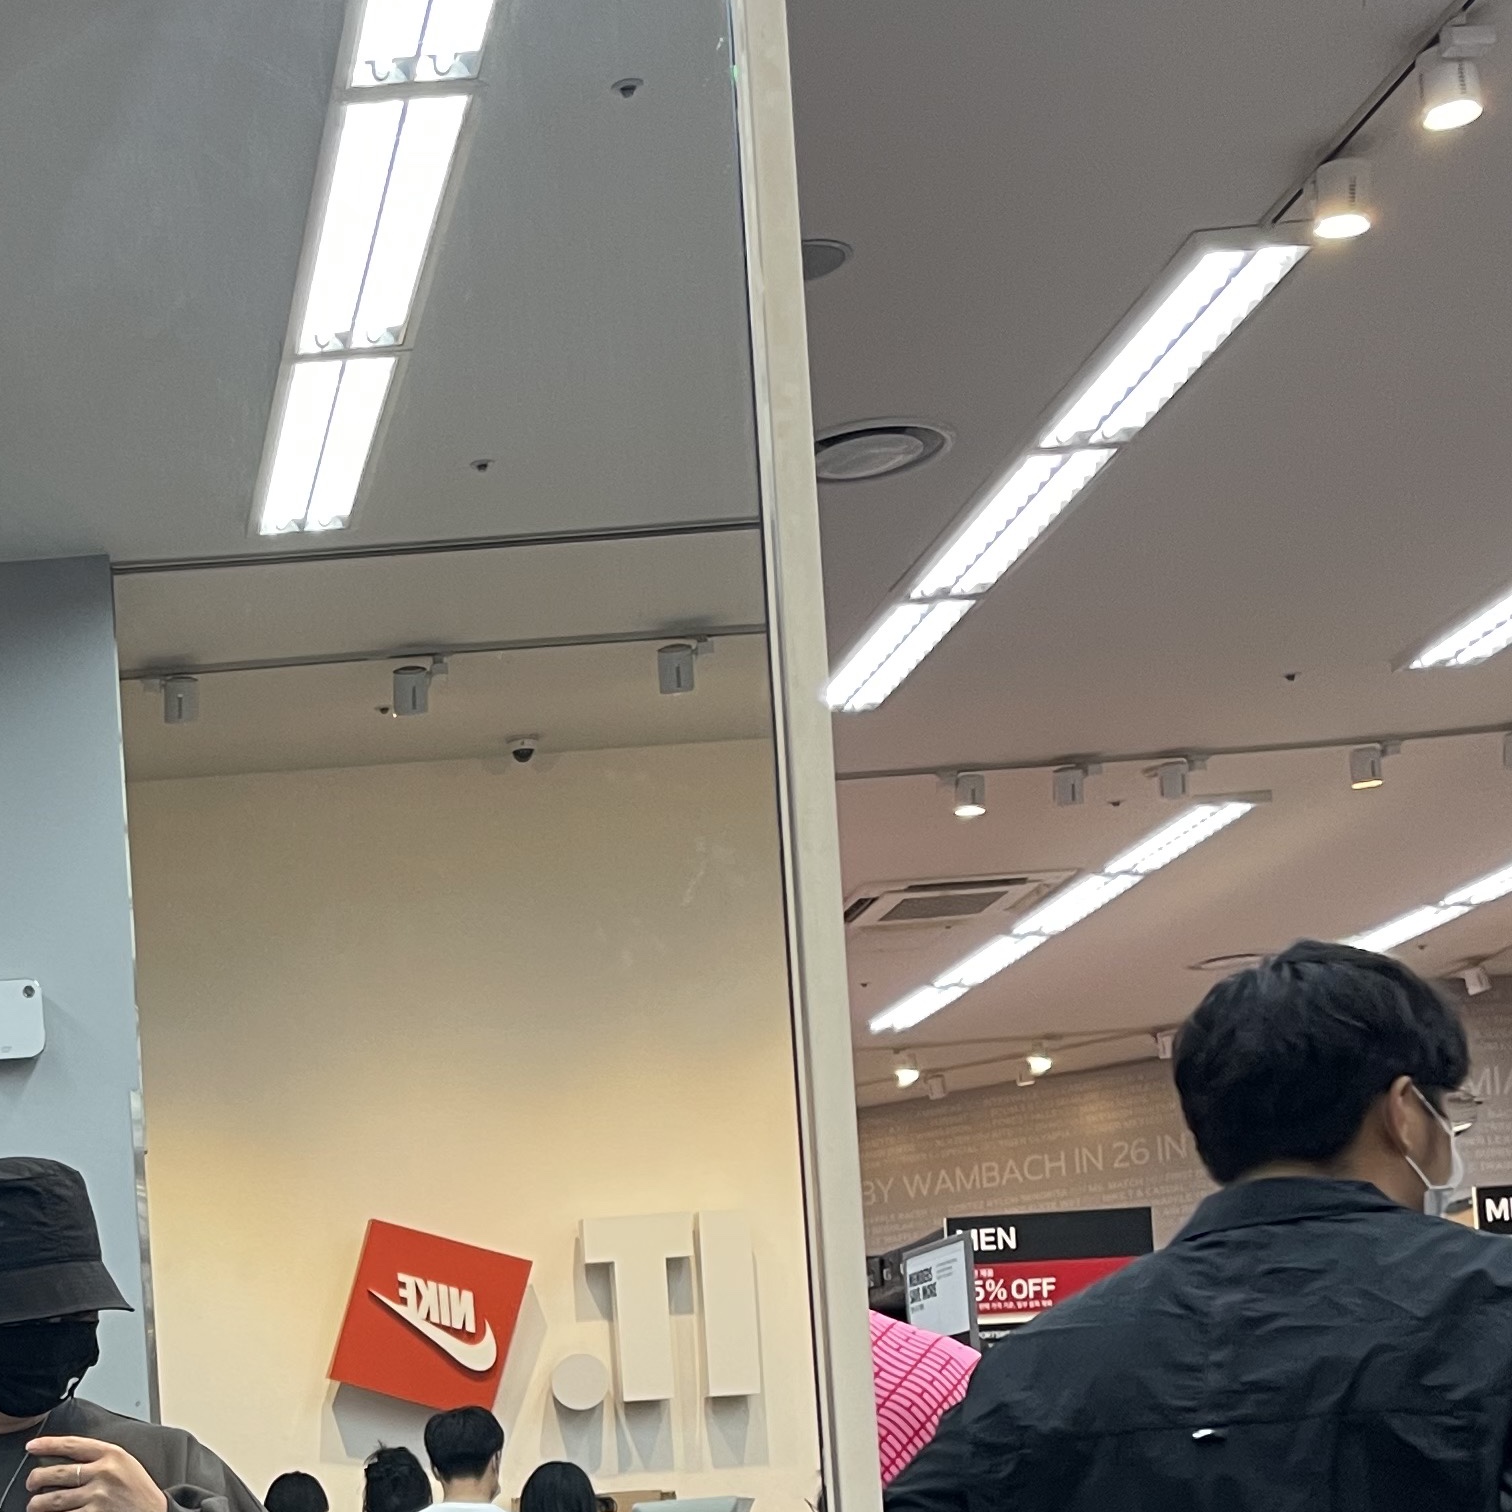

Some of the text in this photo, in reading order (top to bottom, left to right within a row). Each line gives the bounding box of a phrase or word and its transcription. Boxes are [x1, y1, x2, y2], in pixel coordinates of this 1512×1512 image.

[902, 1150, 1067, 1199] WAMBACH
[1074, 1143, 1104, 1174] IN
[1112, 1137, 1150, 1169] 26
[1485, 1197, 1512, 1223] M
[1011, 1277, 1057, 1300] OFF
